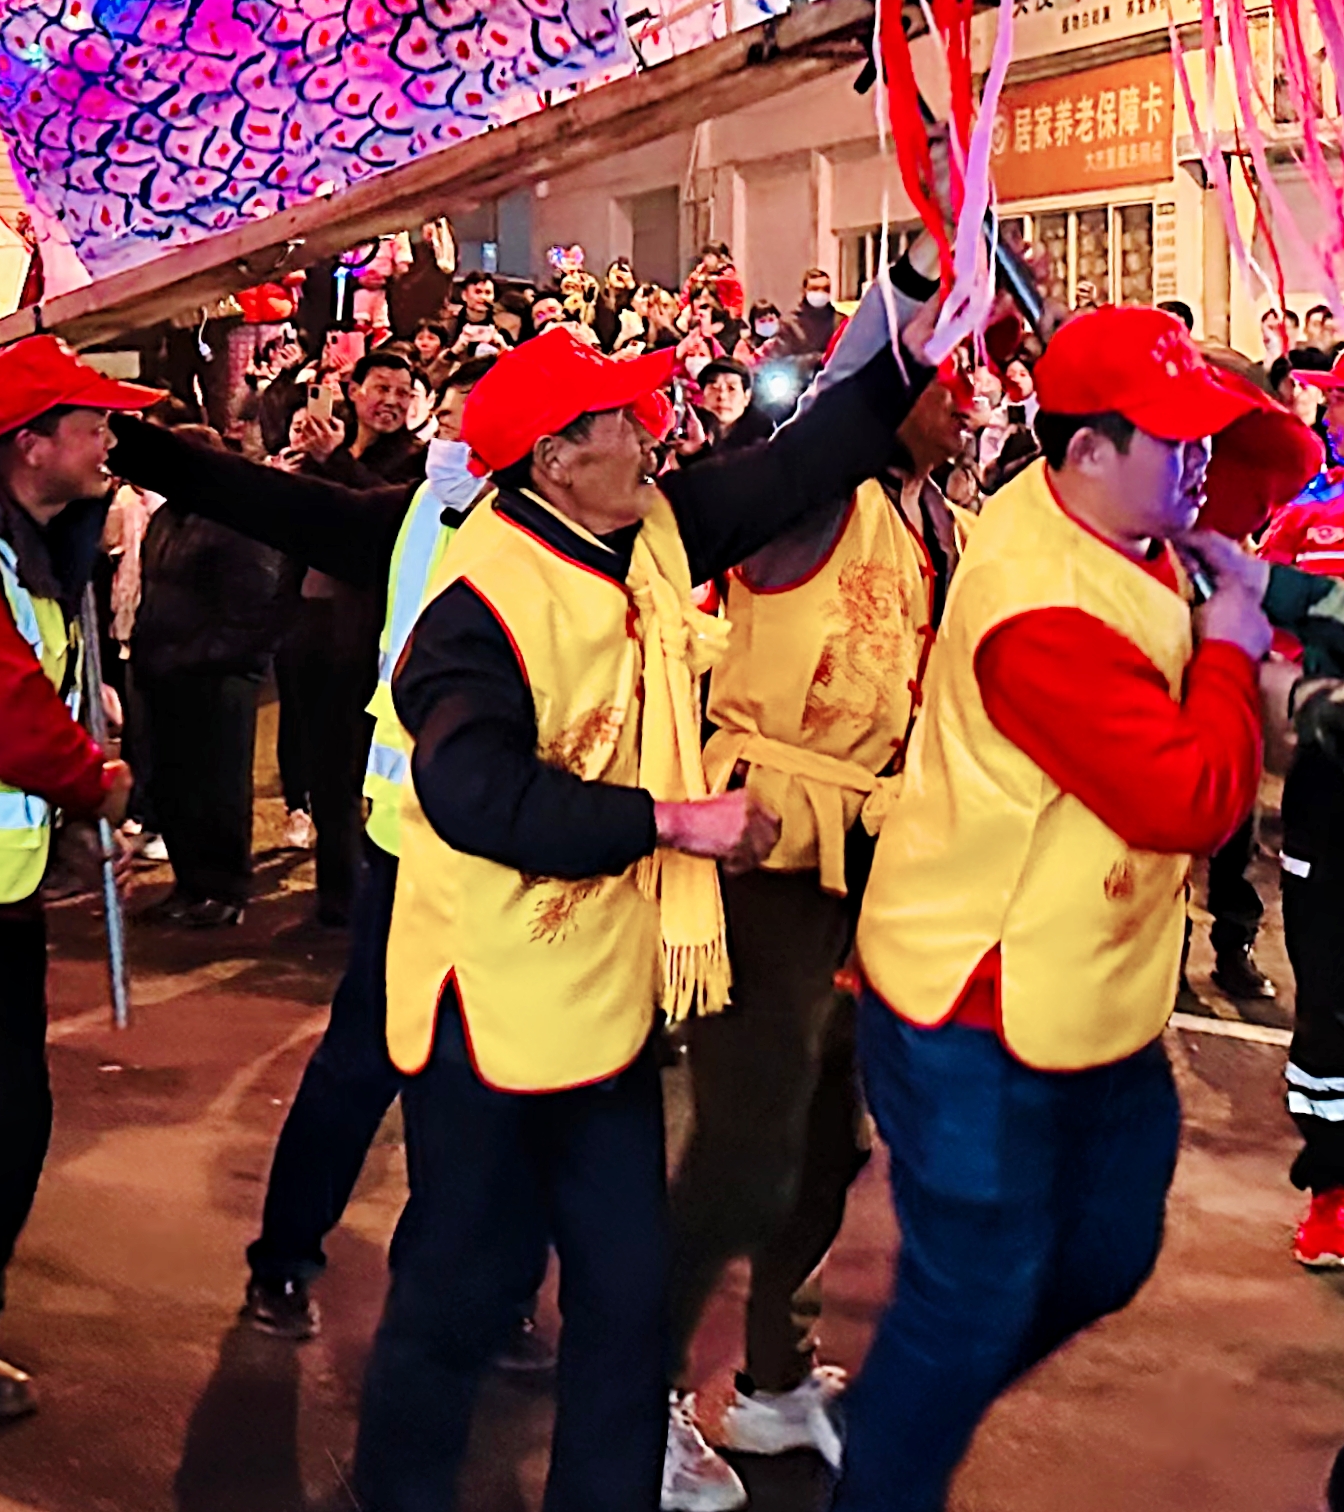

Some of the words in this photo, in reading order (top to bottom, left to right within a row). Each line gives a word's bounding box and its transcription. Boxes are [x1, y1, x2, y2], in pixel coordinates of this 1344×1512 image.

[1014, 80, 1163, 153] 居家养老保障卡
